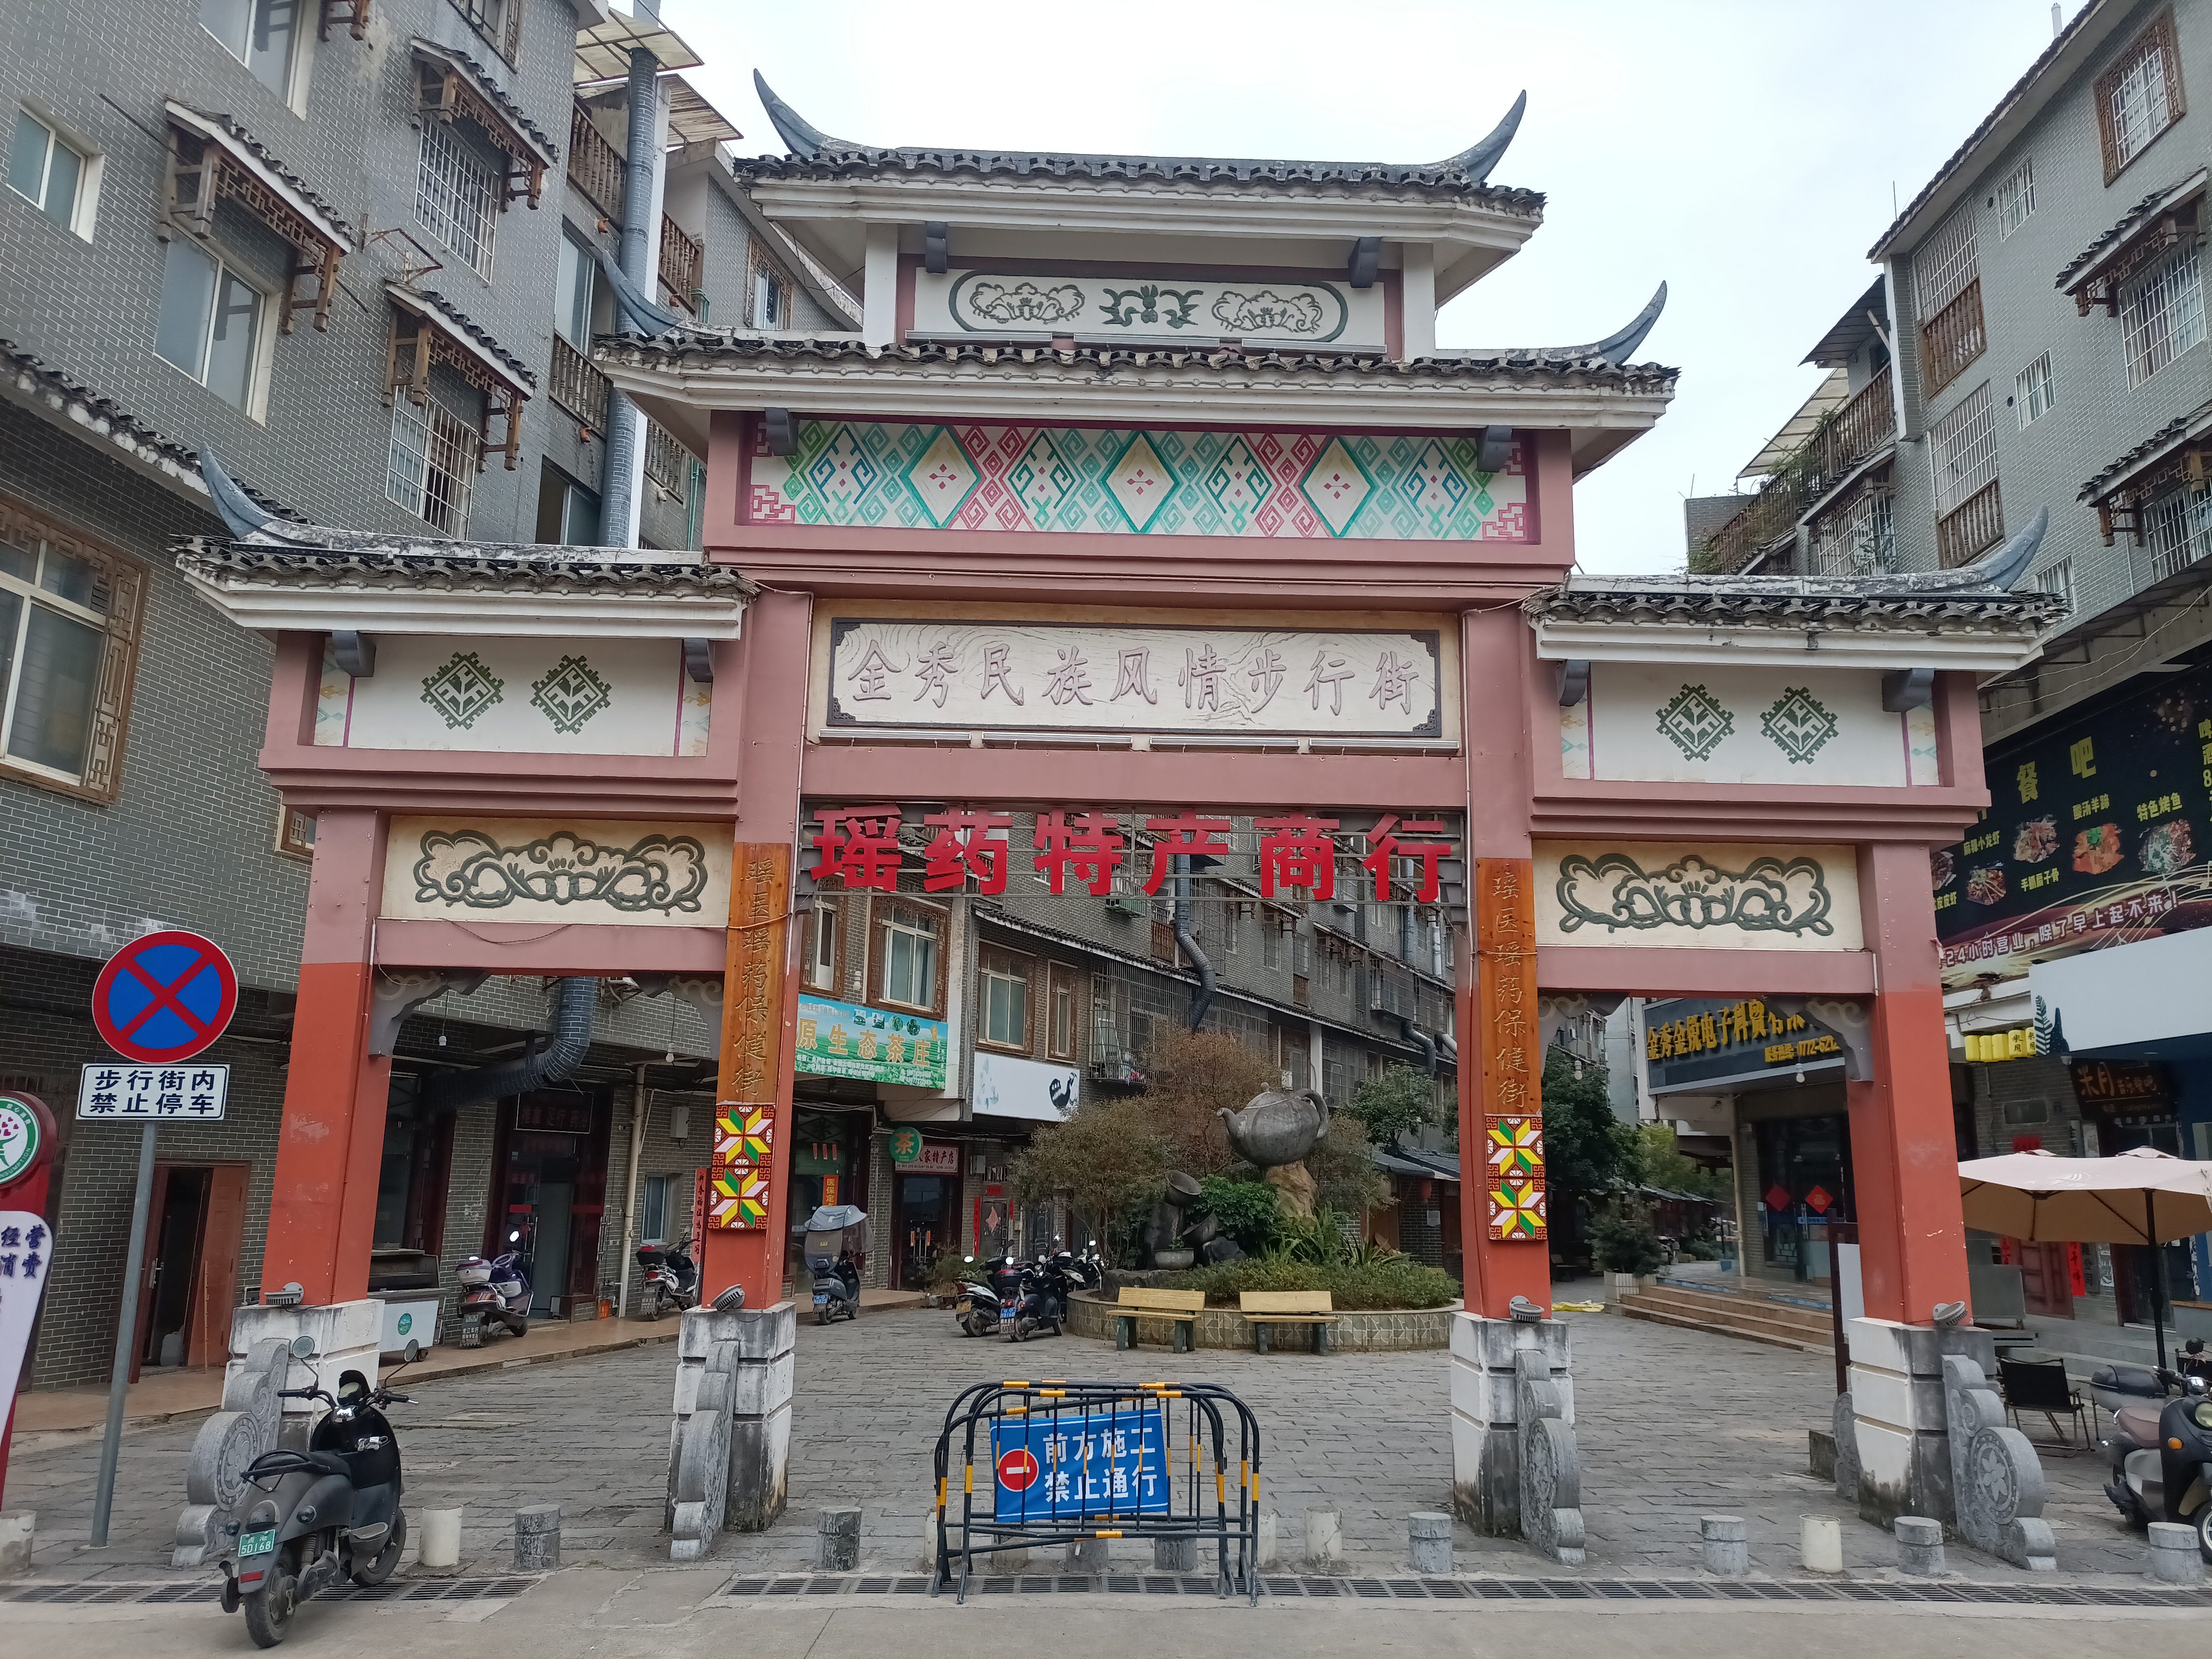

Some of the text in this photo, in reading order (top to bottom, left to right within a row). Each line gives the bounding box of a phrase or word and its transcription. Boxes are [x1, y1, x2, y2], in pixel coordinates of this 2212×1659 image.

[848, 639, 1421, 716] 金秀民族风情步行街
[2137, 793, 2182, 821] 特色烤鱼
[809, 803, 1451, 903] 瑶药特产商行
[1963, 830, 2000, 856] 麻辣小龙虾
[733, 859, 775, 1095] 瑶医瑶药保健街
[1491, 871, 1530, 1108] 瑶医瑶药保健街
[795, 1017, 931, 1066] 原生态茶庄
[95, 1070, 215, 1091] 步行街内
[89, 1093, 215, 1115] 禁止停车
[895, 1131, 914, 1154] 茶
[1, 1224, 47, 1250] 经营
[1043, 1427, 1155, 1464] 前方施工
[1044, 1467, 1158, 1503] 禁止通行
[241, 1541, 271, 1554] 5D168
